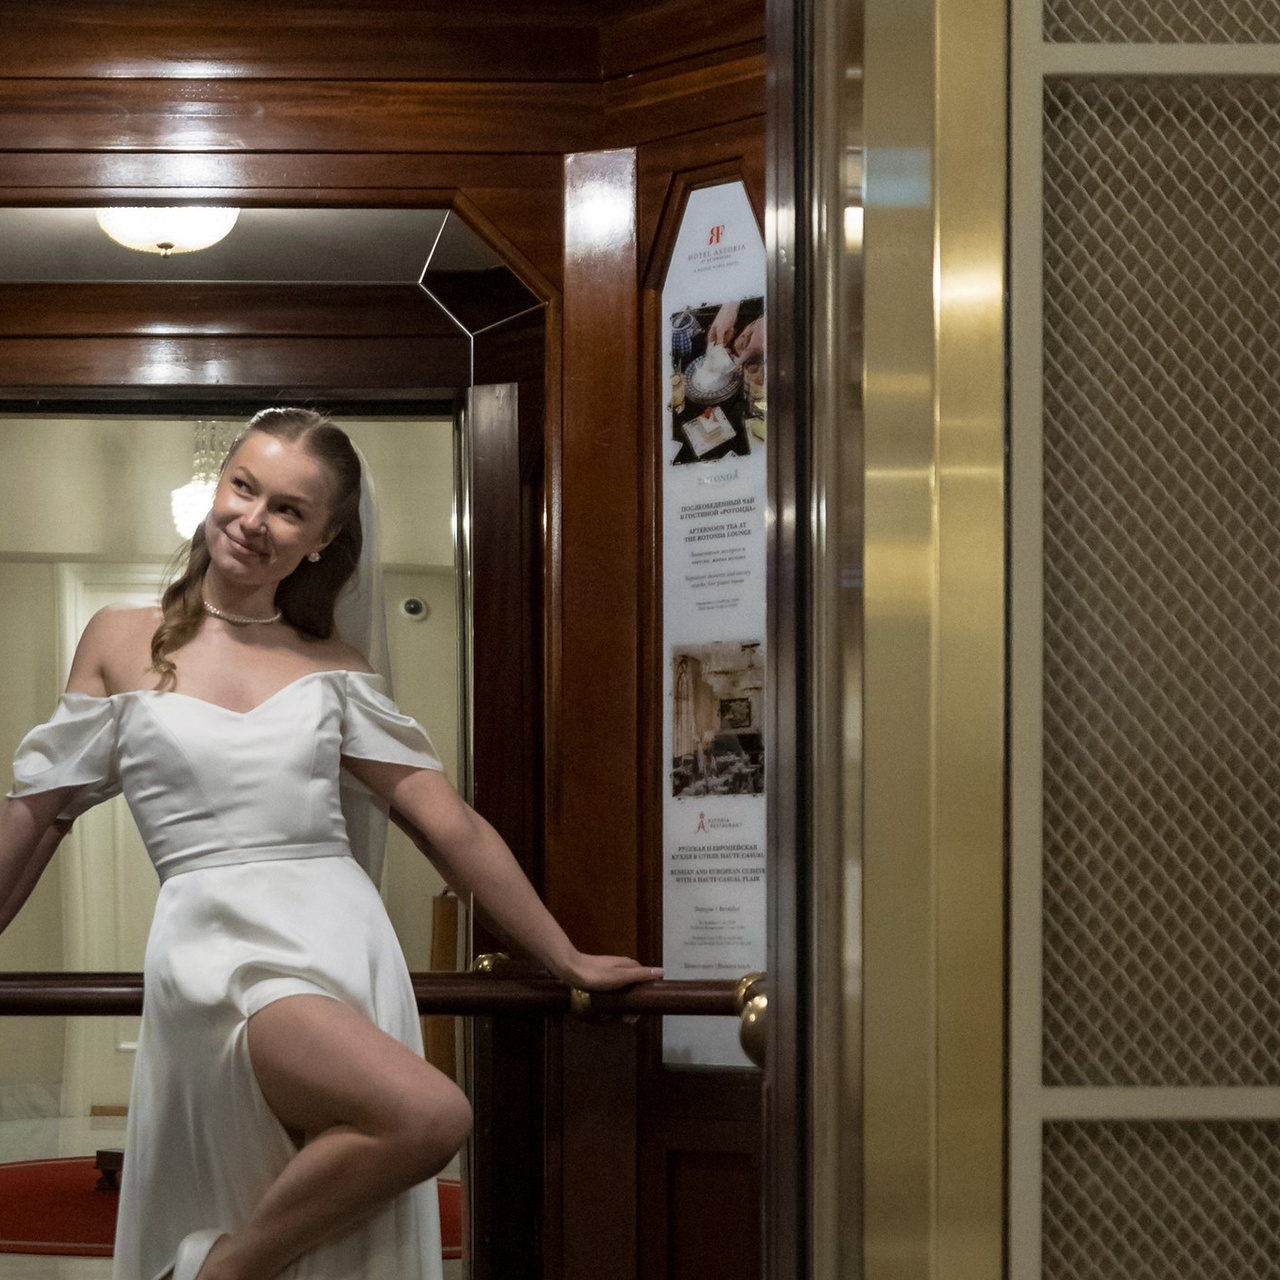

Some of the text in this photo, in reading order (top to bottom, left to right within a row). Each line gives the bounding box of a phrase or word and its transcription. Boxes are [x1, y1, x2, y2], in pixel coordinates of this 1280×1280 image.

[688, 251, 711, 261] HOTEL
[714, 244, 746, 256] ASTORIA
[742, 496, 755, 505] ЧАЙ
[685, 510, 719, 519] ГОСТИНОЙ
[689, 525, 725, 534] AFTERNOON
[697, 533, 726, 541] ROTONDA
[727, 529, 752, 537] LOUNGE
